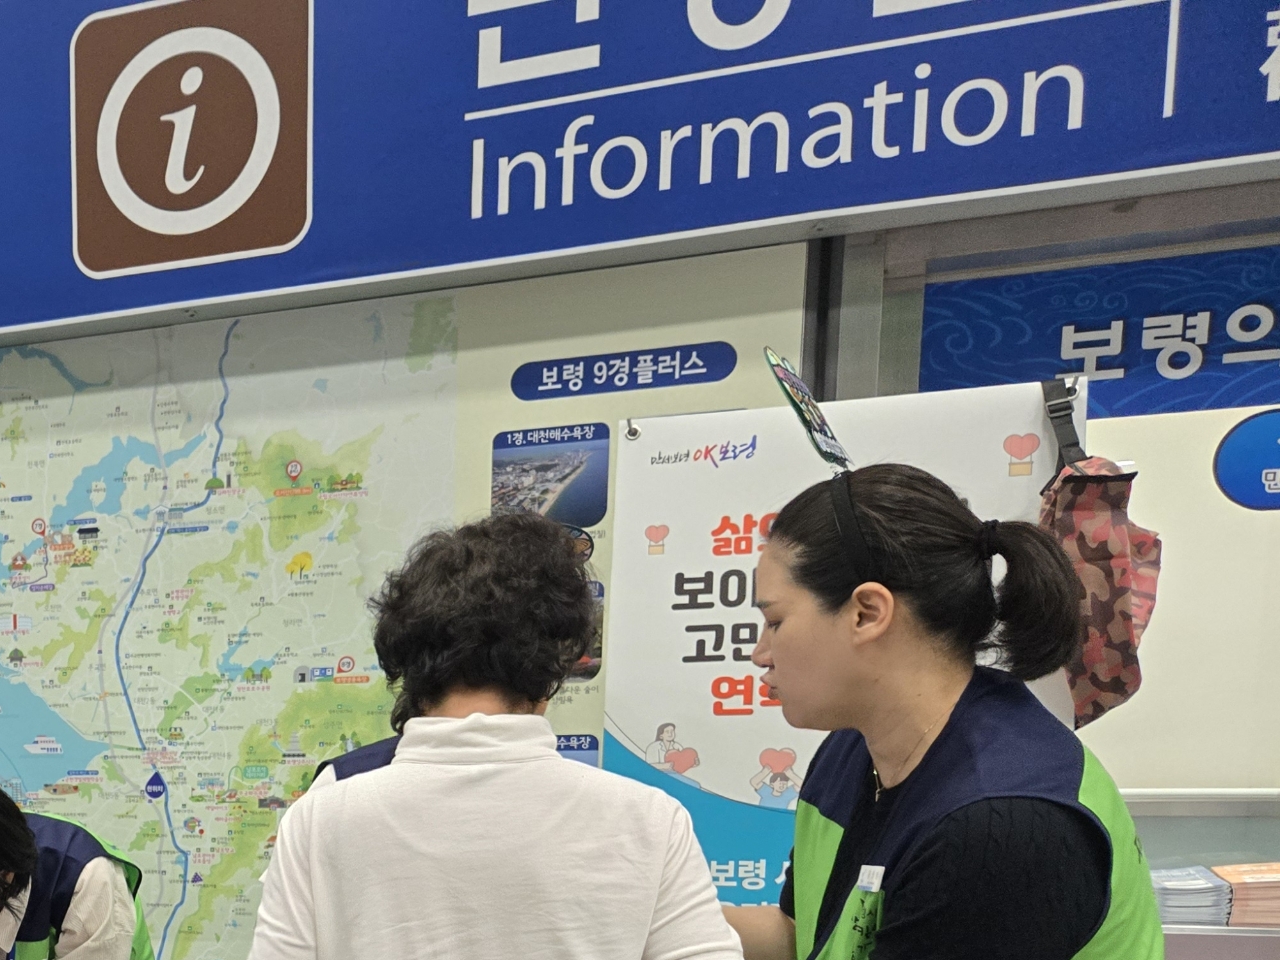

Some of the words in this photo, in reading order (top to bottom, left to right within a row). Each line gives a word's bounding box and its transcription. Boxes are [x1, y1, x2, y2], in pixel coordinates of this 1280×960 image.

[471, 63, 1084, 219] Information
[538, 361, 584, 391] 보령
[593, 351, 707, 386] 9경플러스
[527, 425, 595, 444] 대천해수욕장
